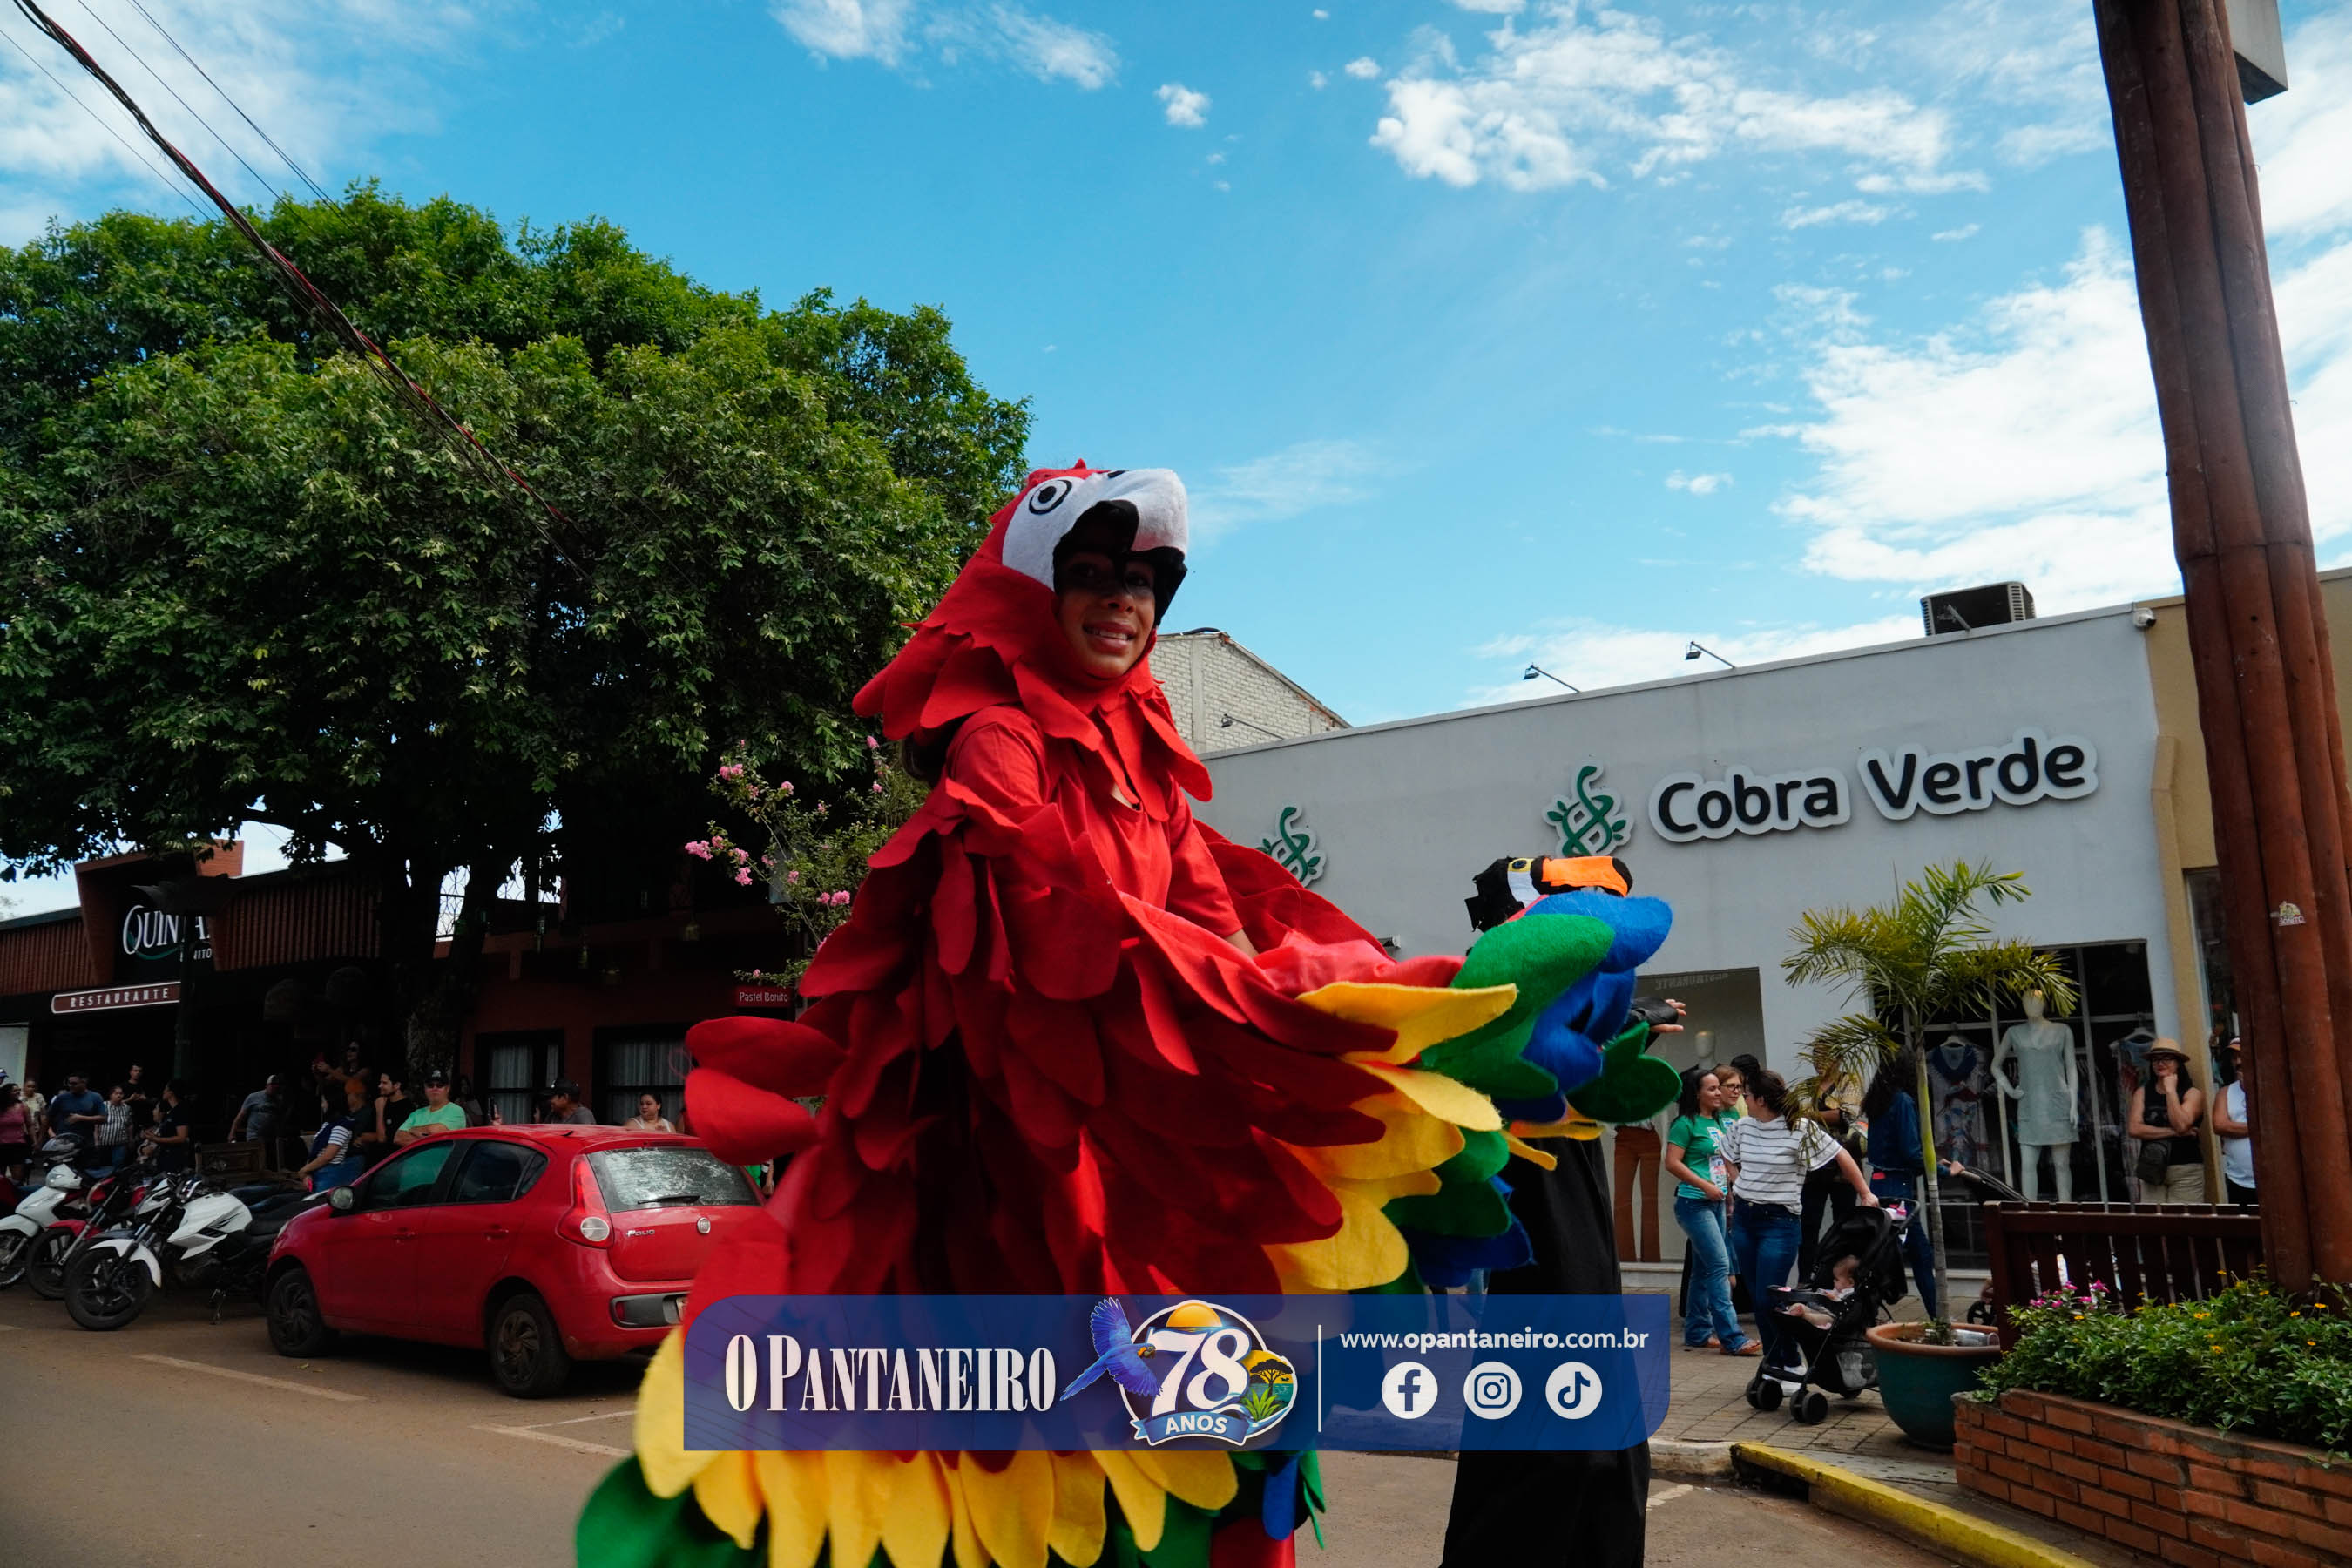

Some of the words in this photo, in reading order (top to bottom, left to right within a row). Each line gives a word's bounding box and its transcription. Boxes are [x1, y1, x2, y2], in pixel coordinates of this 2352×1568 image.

[1658, 774, 1838, 834] Cobra
[1867, 737, 2085, 809] Verde
[70, 988, 169, 1008] RESTAURANTE
[739, 991, 763, 1002] Pastel
[764, 991, 788, 1003] Bonito
